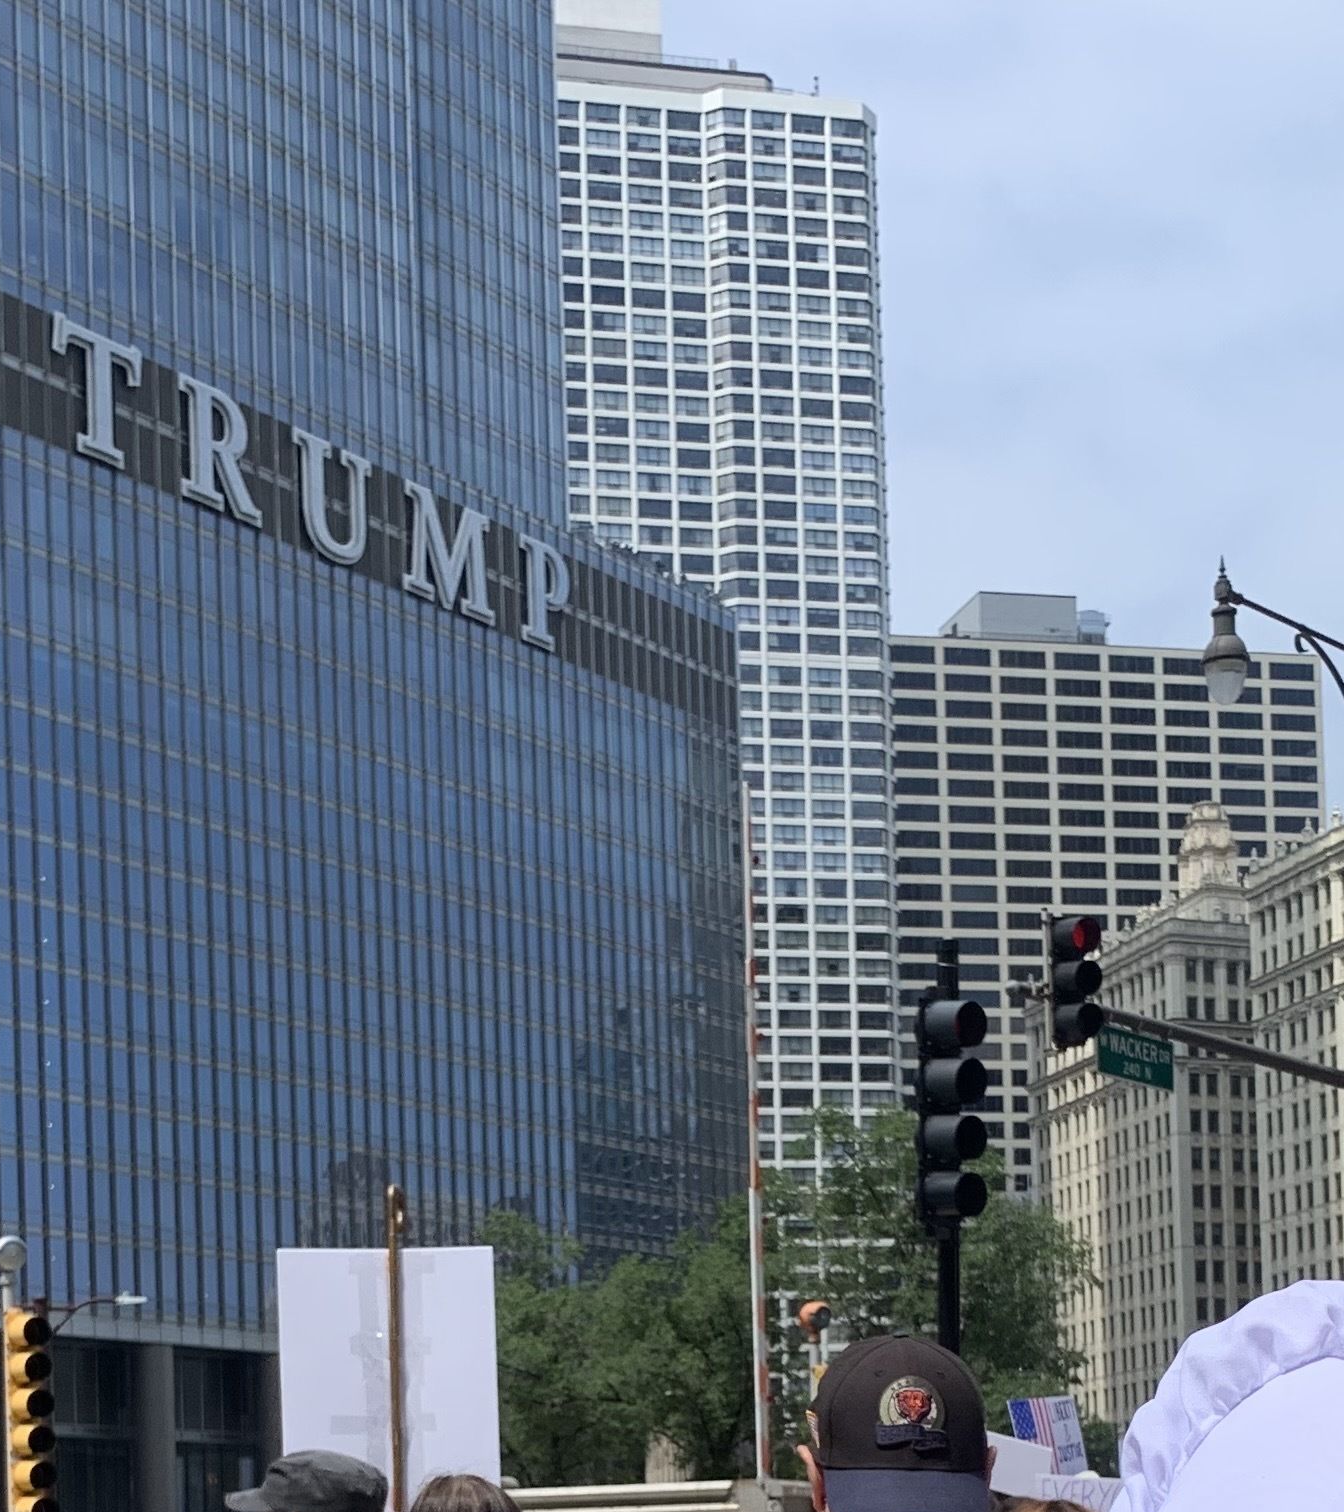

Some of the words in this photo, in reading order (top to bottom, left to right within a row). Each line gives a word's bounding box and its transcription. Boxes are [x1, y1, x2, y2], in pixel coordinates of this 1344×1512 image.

[51, 309, 572, 653] TRUMP
[1109, 1033, 1158, 1065] WACKER
[1159, 1049, 1170, 1064] DR
